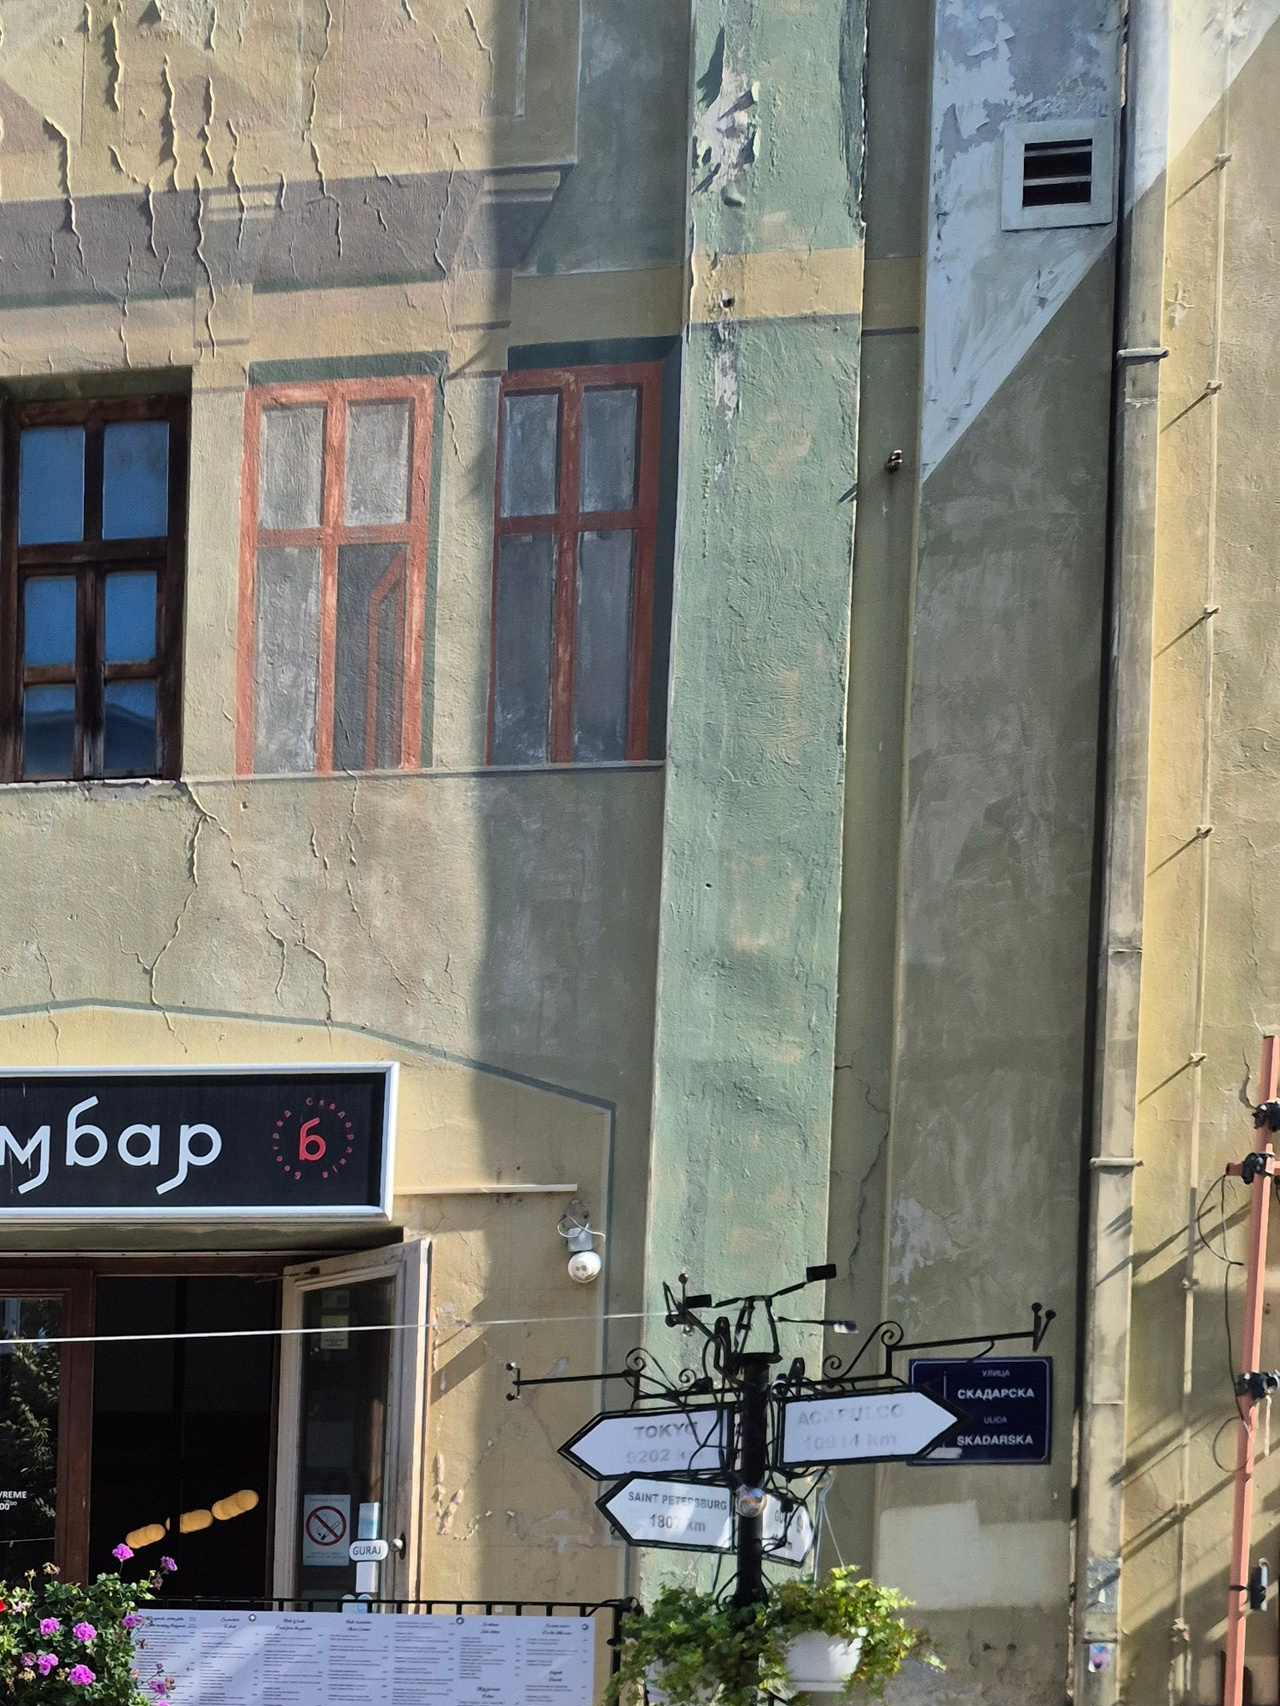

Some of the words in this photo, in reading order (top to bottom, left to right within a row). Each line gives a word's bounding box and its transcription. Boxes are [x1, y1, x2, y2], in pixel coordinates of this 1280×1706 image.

[981, 1369, 1011, 1378] УЛИЦА
[956, 1387, 1036, 1401] СКАДАРСКА
[798, 1402, 904, 1426] ACAPULCO
[983, 1416, 1009, 1425] ULICA
[867, 1433, 897, 1447] km
[956, 1434, 1034, 1447] SKADARSKA
[628, 1491, 660, 1505] SAINT
[661, 1494, 728, 1511] PETERSBURG
[649, 1513, 683, 1529] 1807
[686, 1520, 706, 1532] km
[352, 1546, 382, 1556] GURAJ
